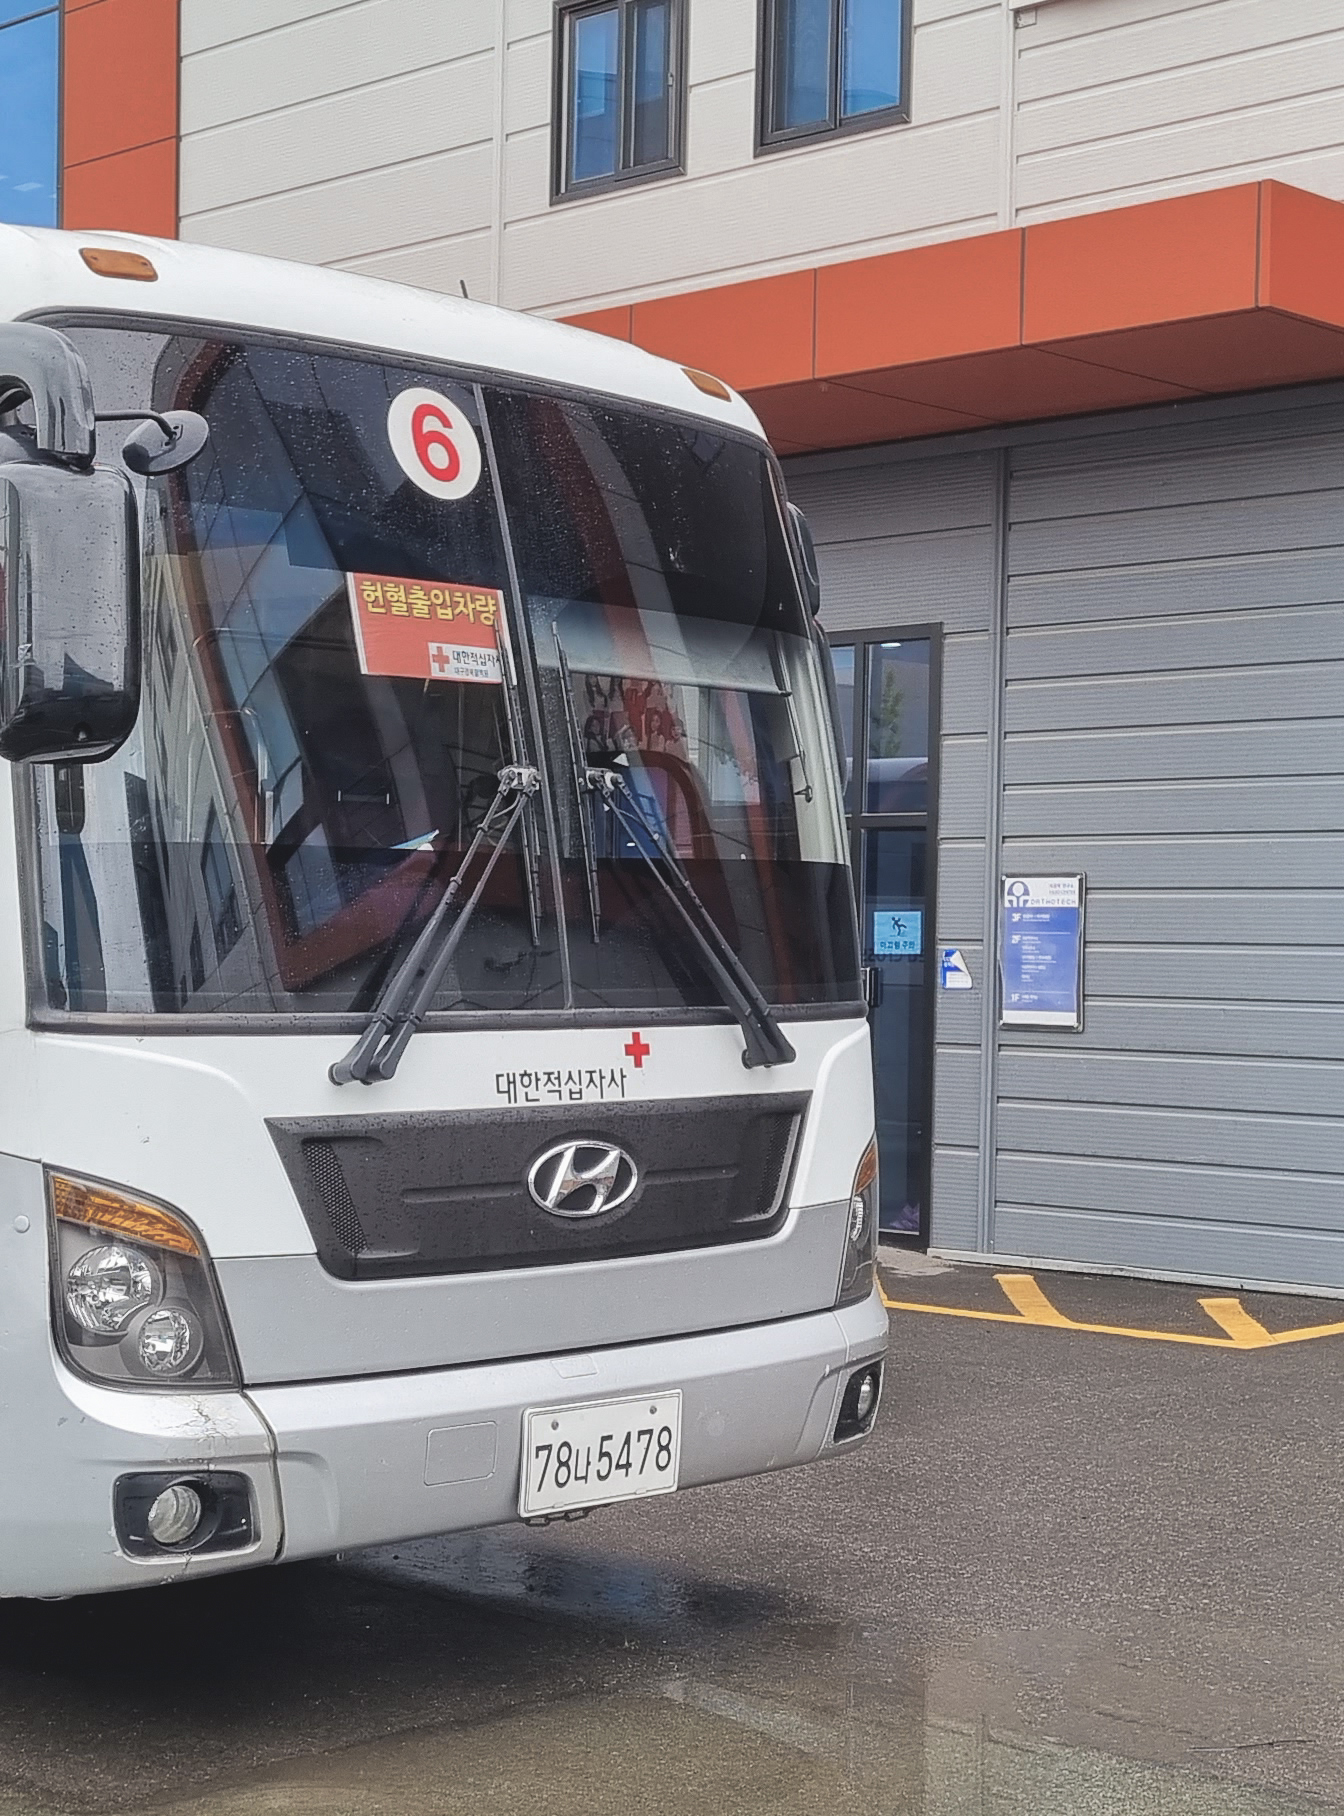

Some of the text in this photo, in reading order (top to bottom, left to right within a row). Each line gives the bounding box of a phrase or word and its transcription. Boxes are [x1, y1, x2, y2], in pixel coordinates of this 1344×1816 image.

[411, 403, 460, 482] 6
[360, 581, 497, 626] 헌혈출입차량
[495, 1067, 627, 1104] 대한적십자사
[535, 1425, 672, 1493] 78나5478
